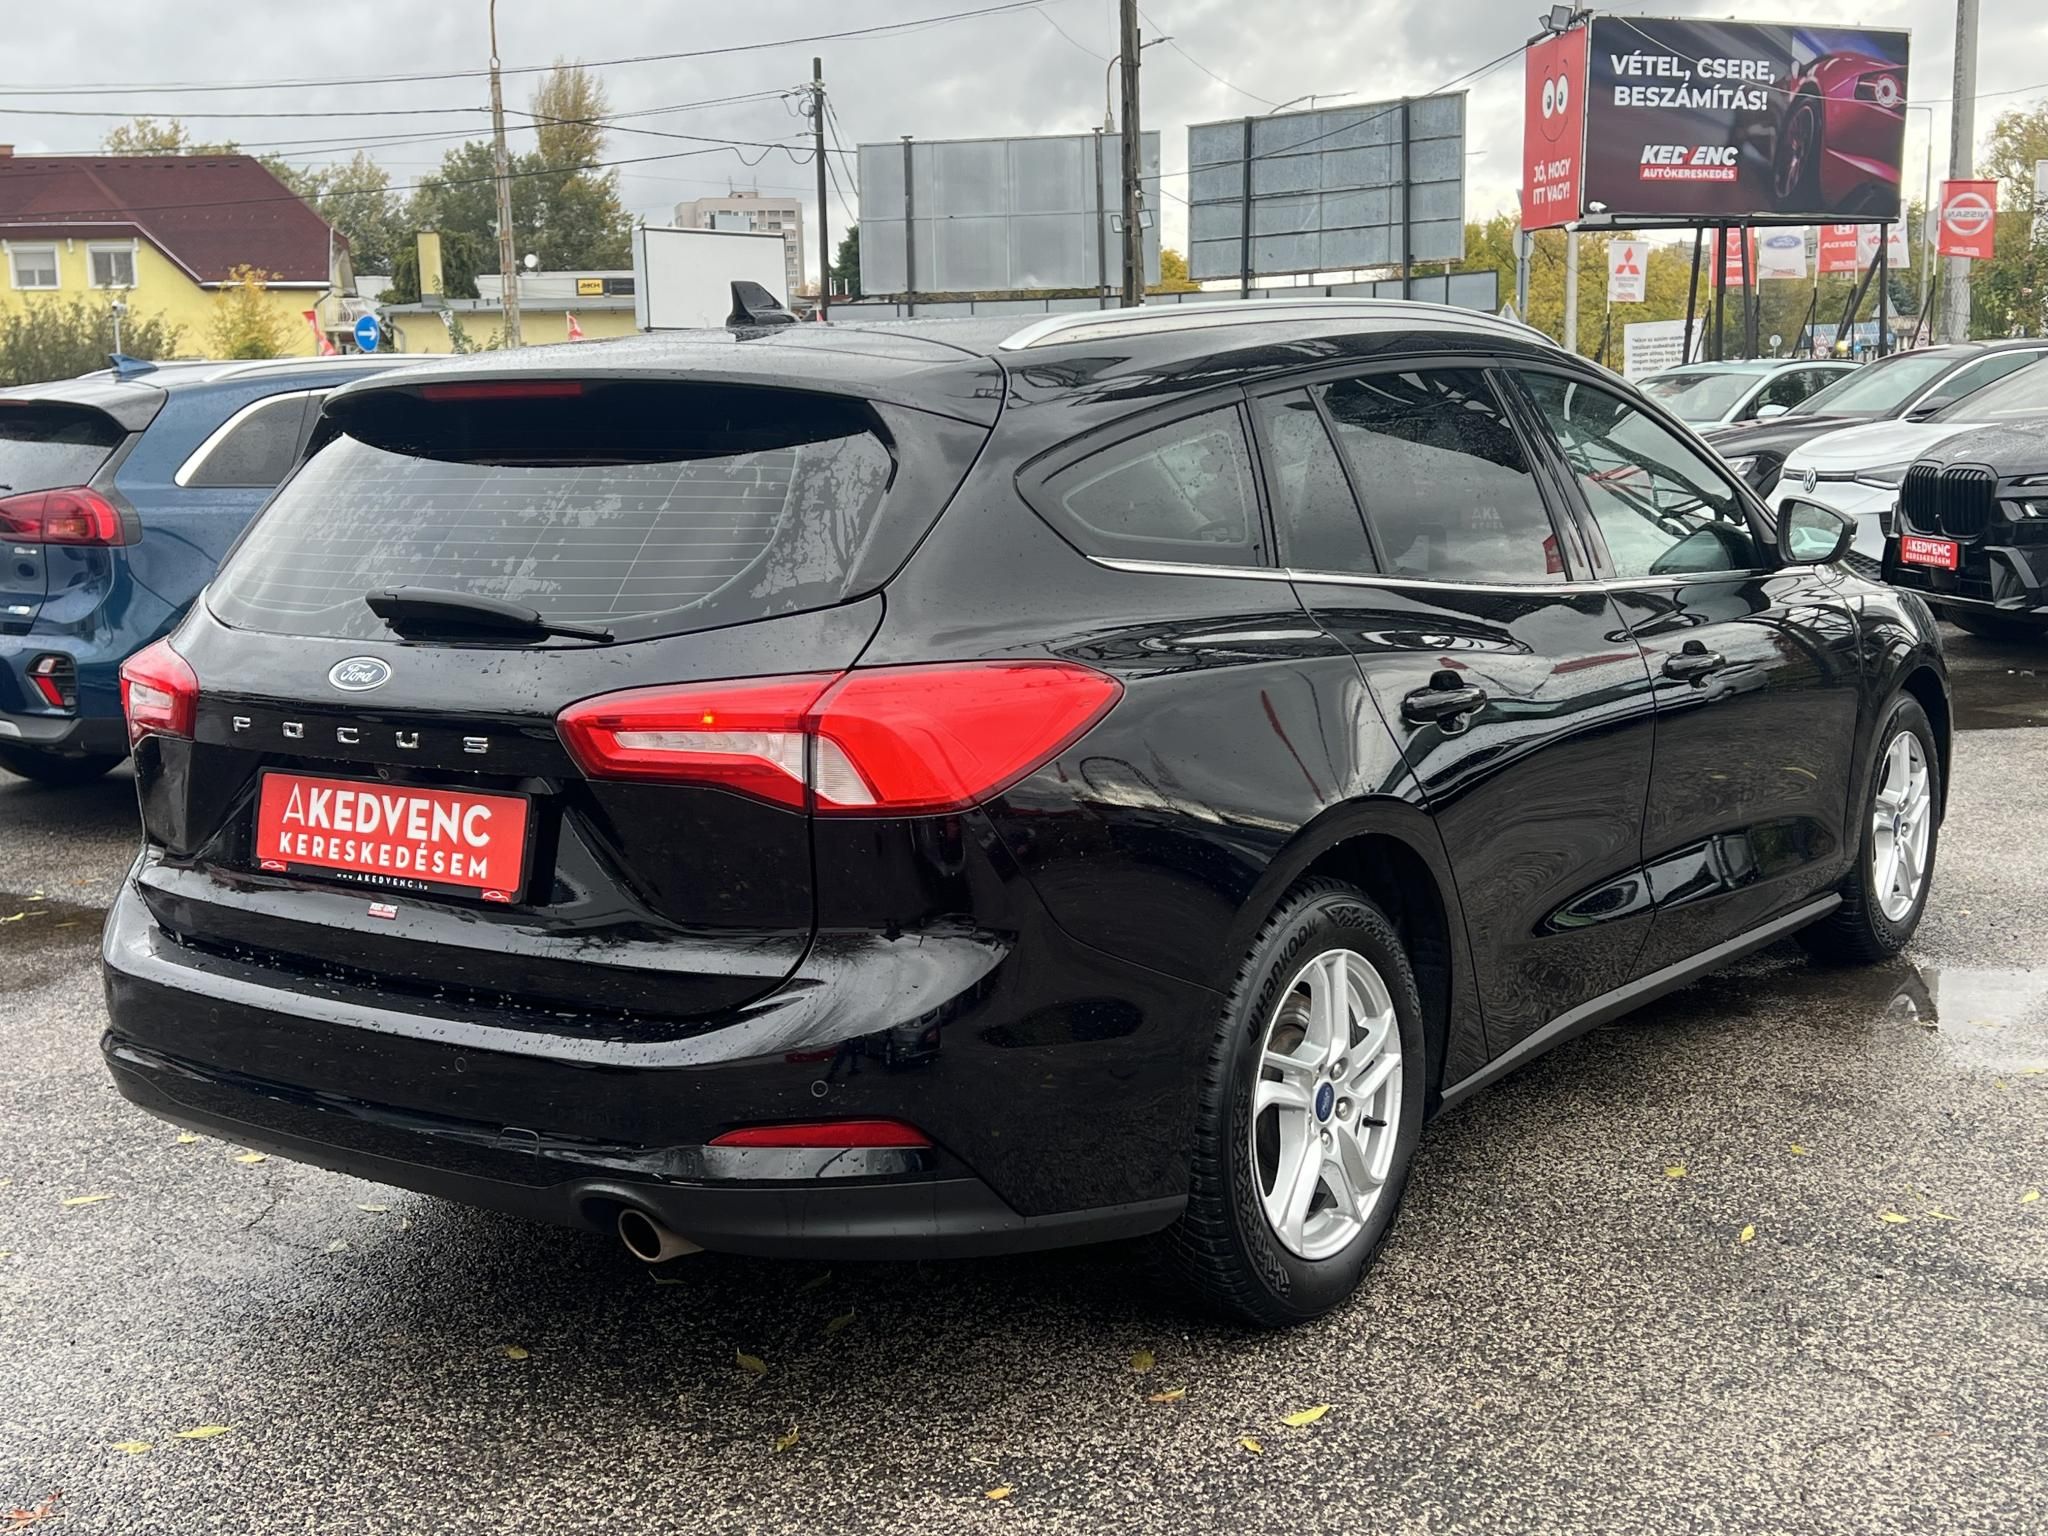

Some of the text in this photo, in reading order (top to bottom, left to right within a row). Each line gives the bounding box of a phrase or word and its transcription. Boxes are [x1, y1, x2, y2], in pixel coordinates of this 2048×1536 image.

[1611, 50, 1775, 84] VÉTEL, CSERE,
[1614, 83, 1768, 111] BESZÁMÍTÁS!
[1533, 157, 1571, 183] JÓ, HOGY
[1642, 166, 1735, 180] AUTÓKERESKEDÉS
[1533, 181, 1571, 205] ITT VAGY!
[1906, 539, 1951, 557] AKEDVENC
[232, 715, 489, 754] FOCUS
[281, 782, 492, 848] AKEDVENC
[278, 831, 488, 879] KERESKEDÉSEM
